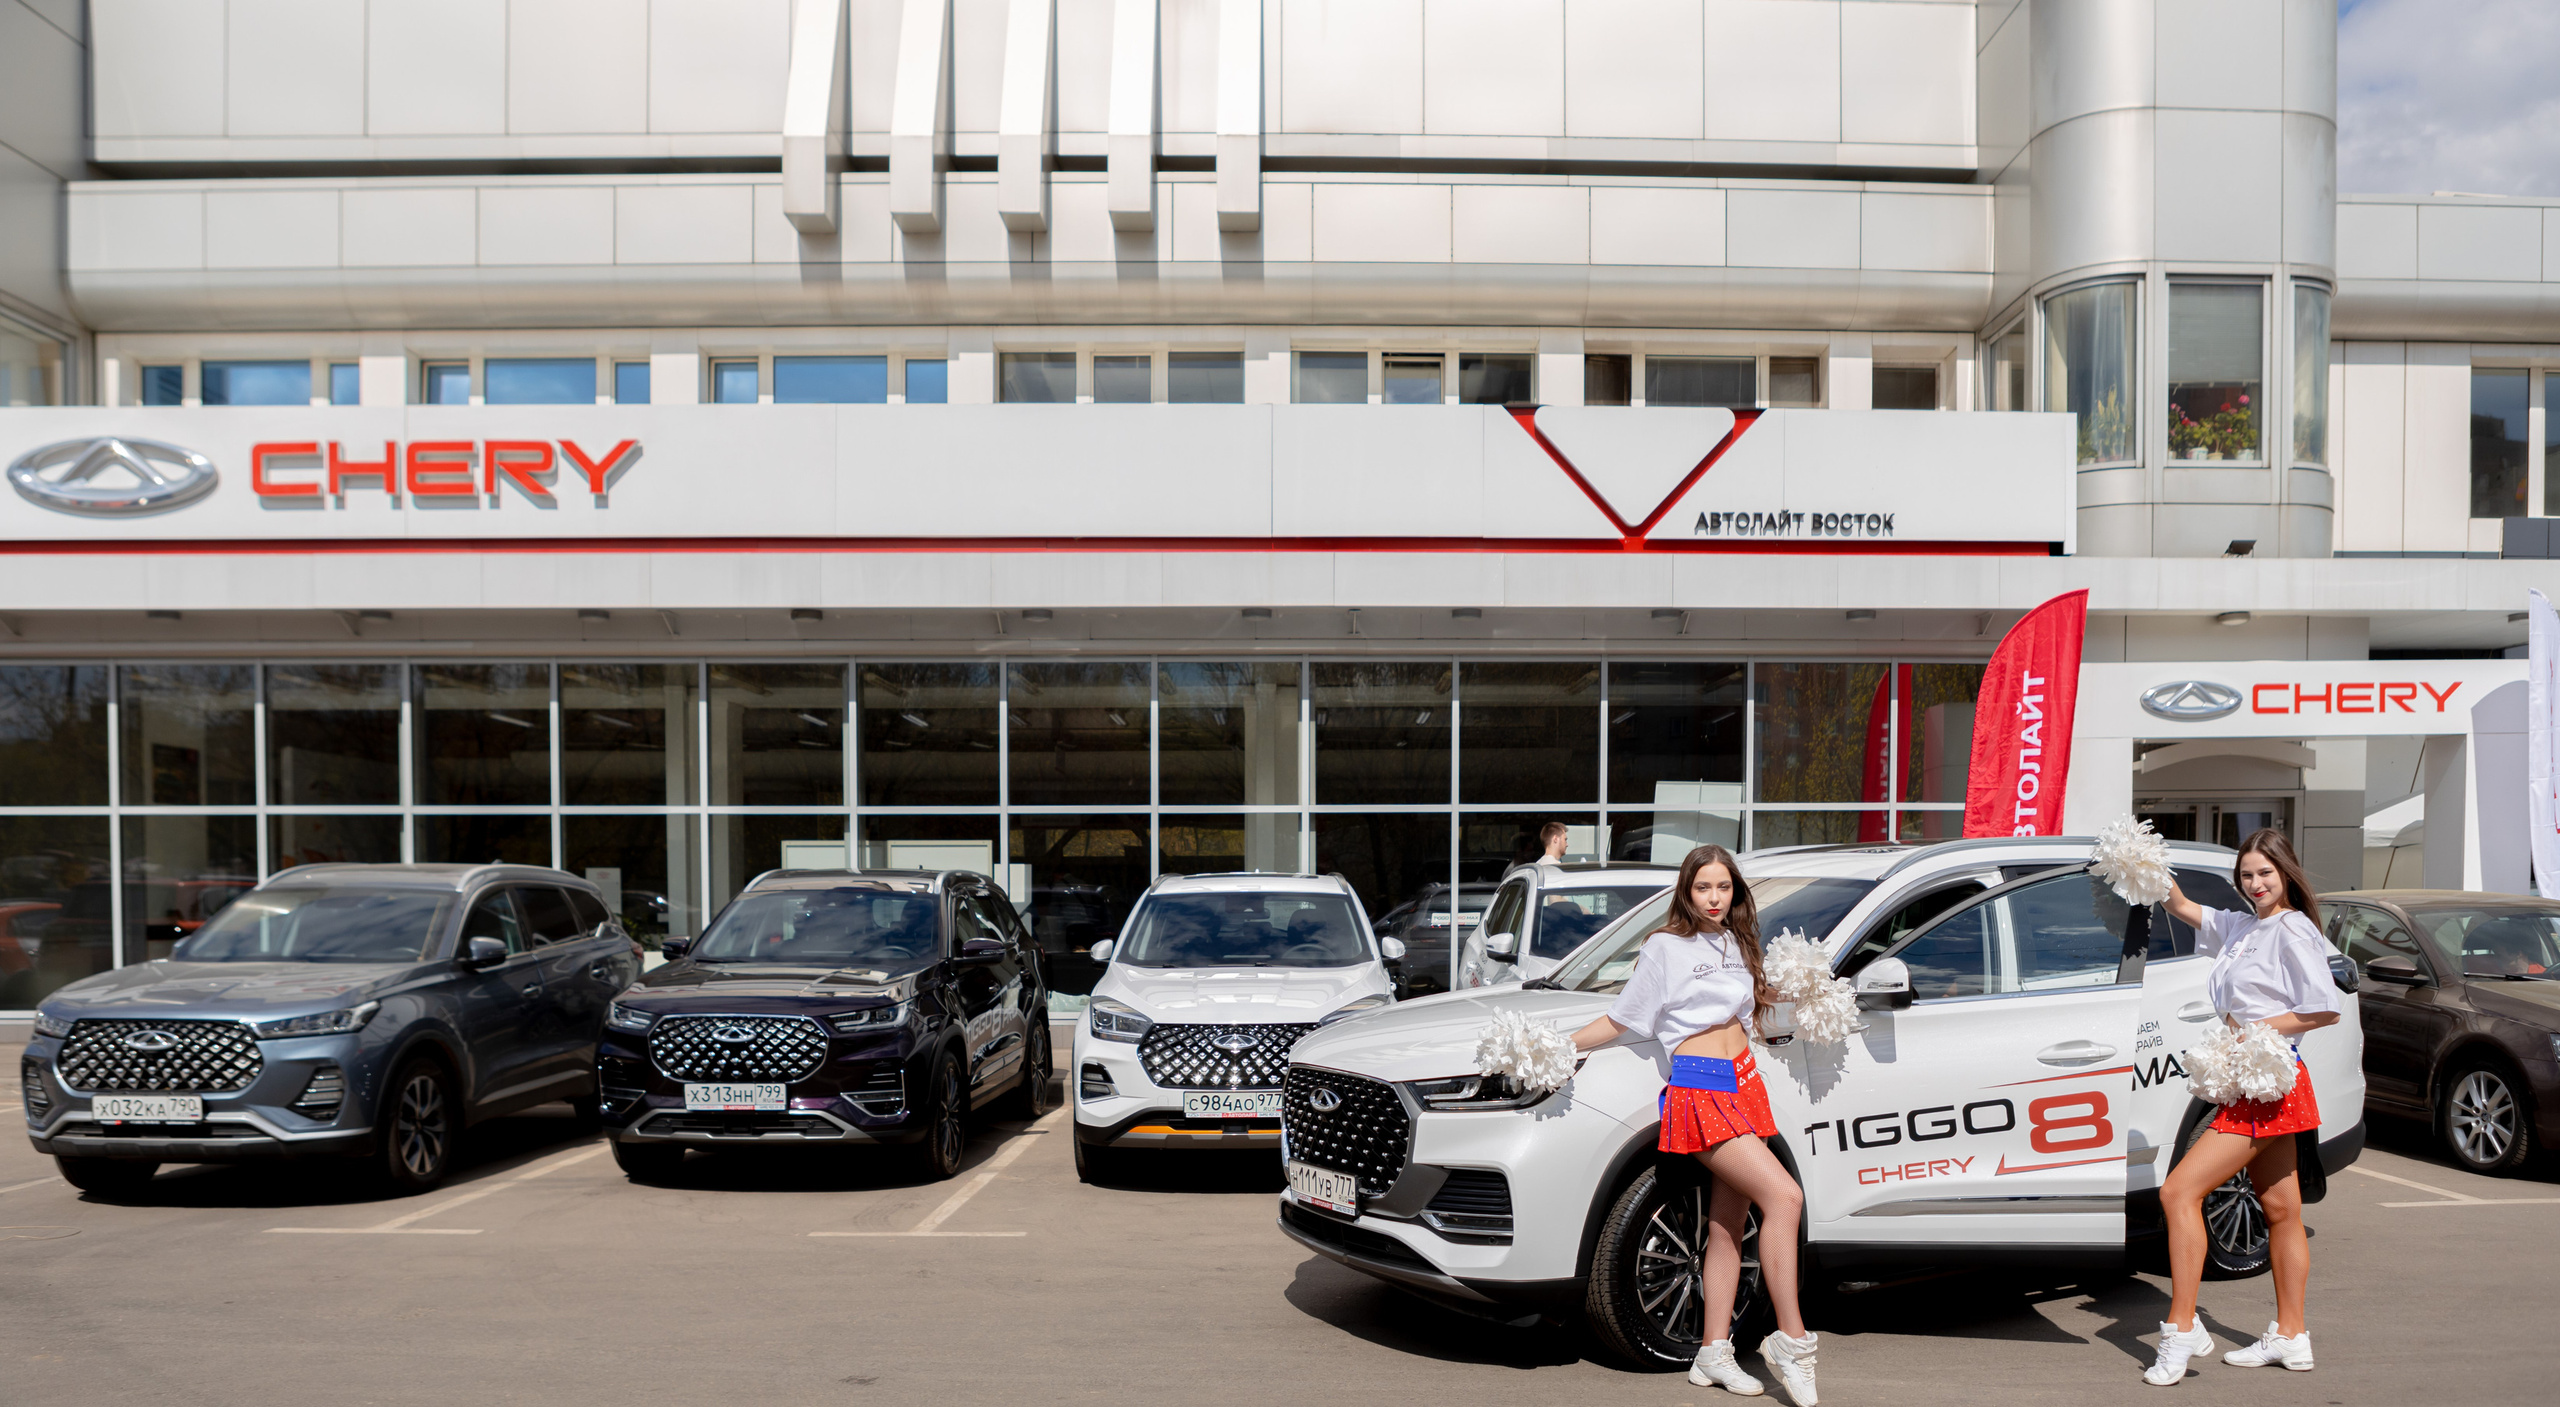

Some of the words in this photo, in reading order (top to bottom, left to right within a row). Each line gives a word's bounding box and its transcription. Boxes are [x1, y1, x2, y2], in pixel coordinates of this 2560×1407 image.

[252, 440, 639, 502] CHERY
[1695, 509, 1805, 534] АВТОЛАЙТ
[1811, 512, 1894, 535] ВОСТОК
[2252, 681, 2463, 714] CHERY
[2131, 1050, 2190, 1092] MA
[169, 1098, 196, 1112] 790
[757, 1085, 781, 1099] 799
[1257, 1093, 1282, 1107] 977
[1804, 1098, 2016, 1157] TIGGO
[2028, 1090, 2114, 1155] 8
[1857, 1155, 1976, 1186] CHERY
[1334, 1174, 1352, 1197] 777
